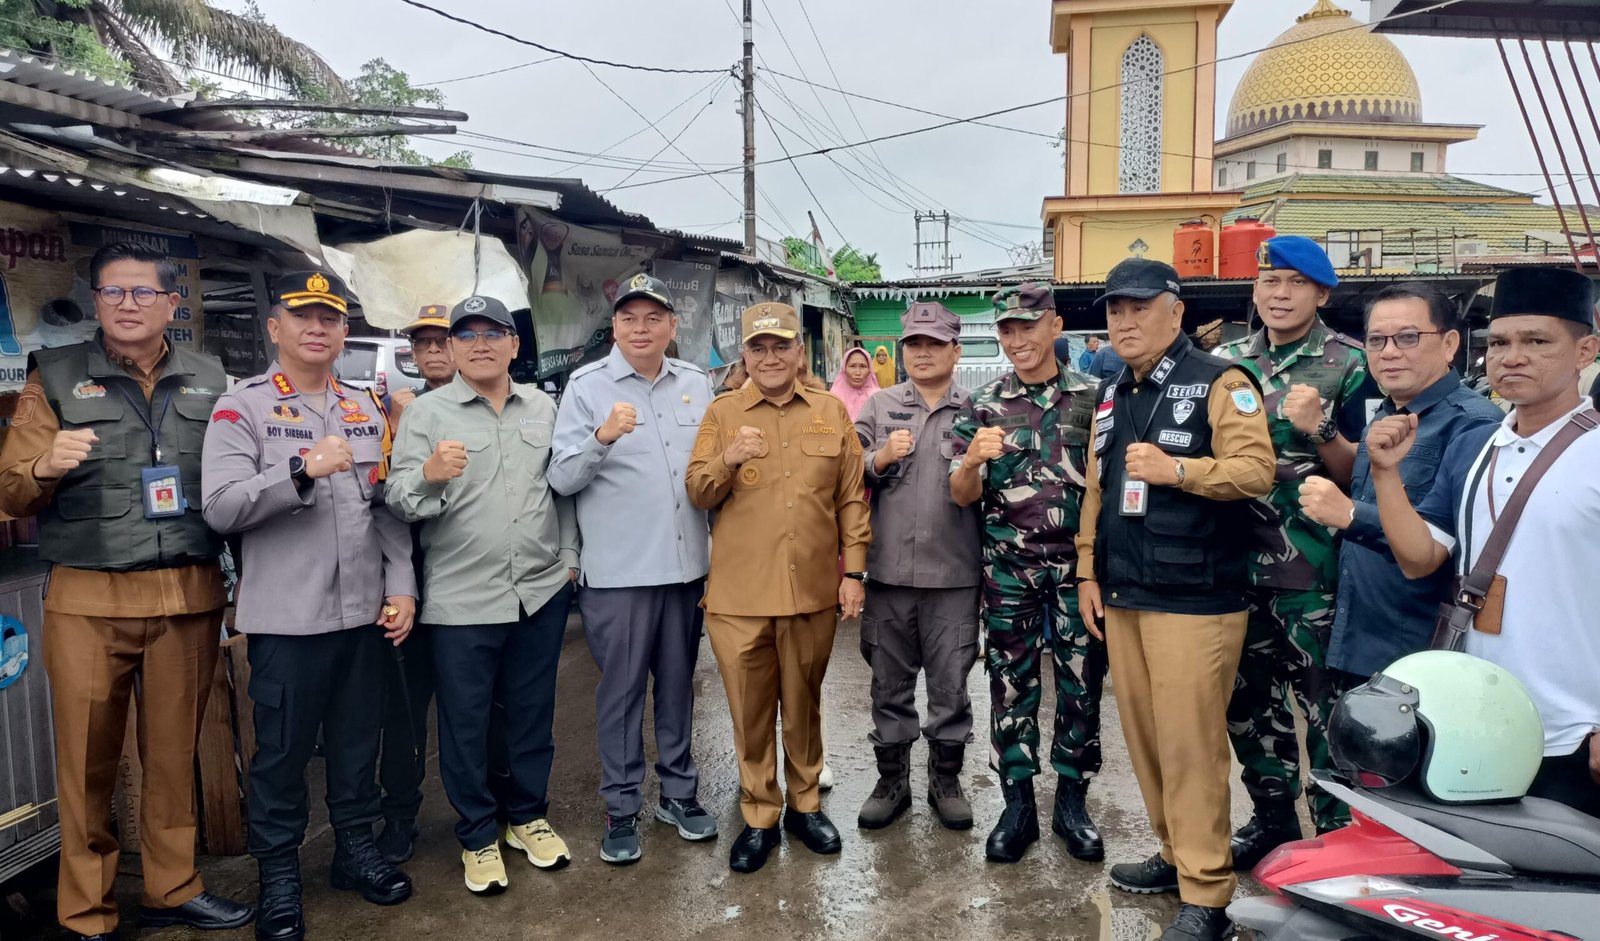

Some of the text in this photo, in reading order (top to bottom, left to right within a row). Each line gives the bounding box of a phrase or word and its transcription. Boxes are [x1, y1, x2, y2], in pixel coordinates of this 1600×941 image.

[167, 328, 193, 342] TEH
[267, 425, 313, 440] BOY SIREGAR
[344, 425, 379, 438] POLRI
[1161, 432, 1190, 444] RESCUE
